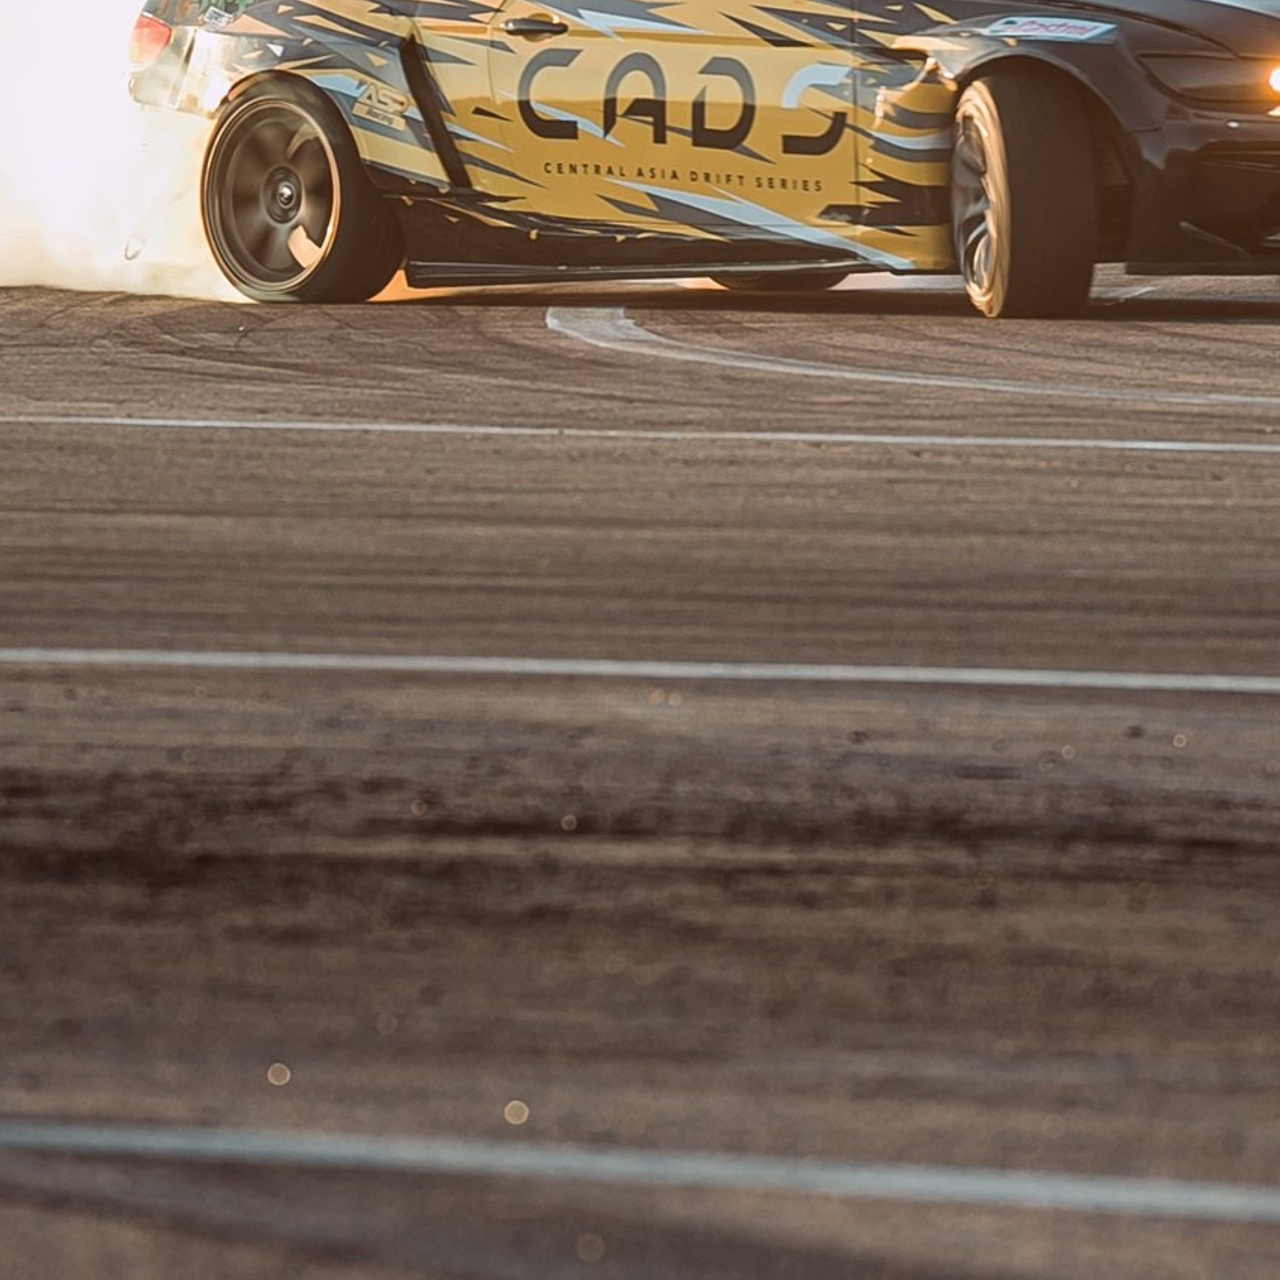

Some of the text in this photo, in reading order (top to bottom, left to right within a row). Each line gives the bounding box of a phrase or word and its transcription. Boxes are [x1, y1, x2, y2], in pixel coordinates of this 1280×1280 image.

[357, 82, 409, 114] ASP
[517, 47, 854, 156] CADS
[543, 162, 824, 193] CENTRAL ASIA DRIFT SERIES
